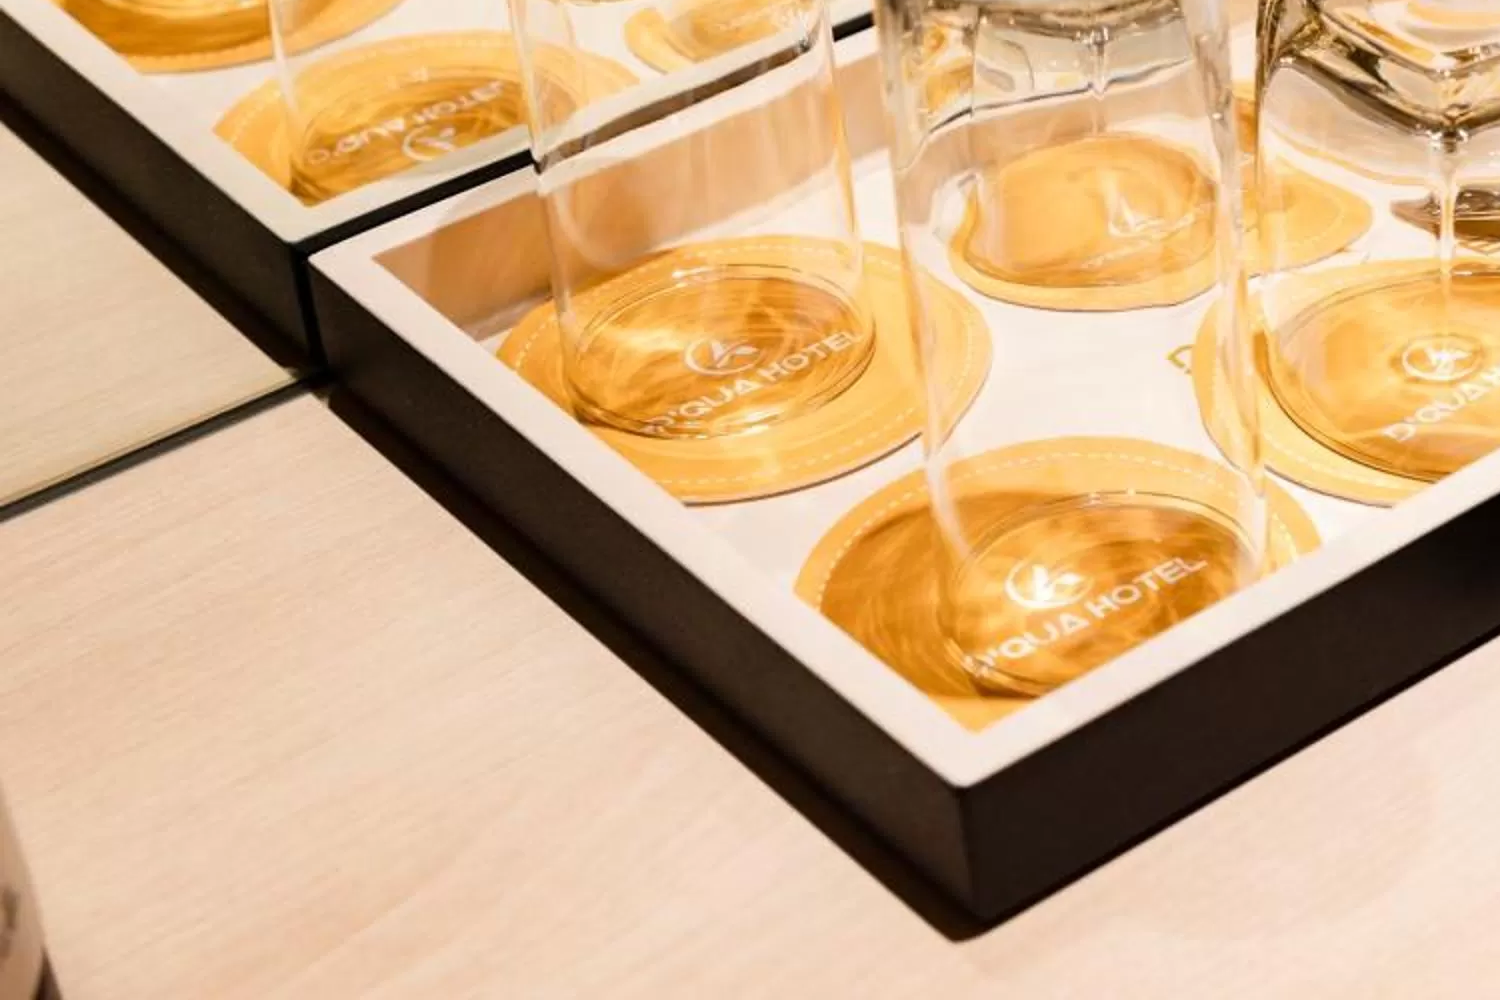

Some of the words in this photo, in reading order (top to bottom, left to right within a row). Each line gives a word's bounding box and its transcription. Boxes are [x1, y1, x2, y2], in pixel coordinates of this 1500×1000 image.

[757, 330, 863, 382] HOTEL
[1382, 380, 1490, 443] D'QUA
[1085, 555, 1209, 620] HOTEL
